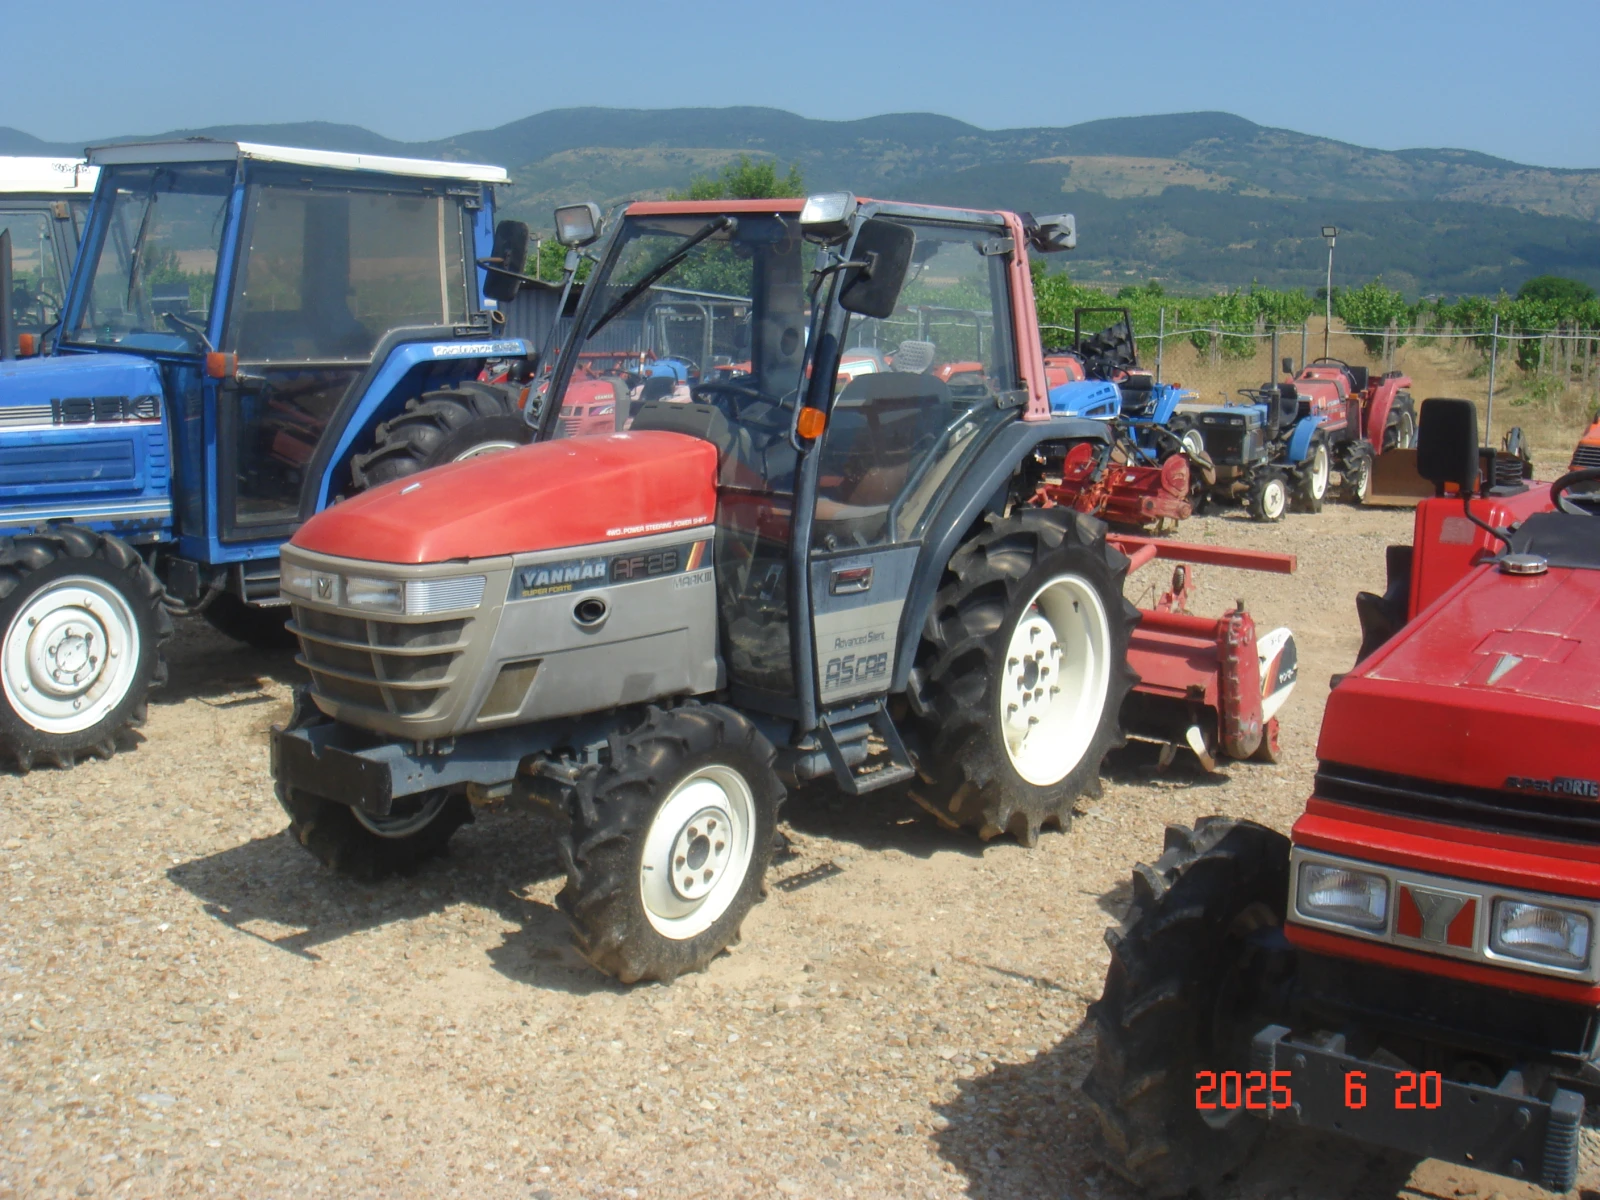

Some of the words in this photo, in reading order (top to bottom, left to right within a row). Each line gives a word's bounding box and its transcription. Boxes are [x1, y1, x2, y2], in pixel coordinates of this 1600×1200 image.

[51, 394, 161, 426] ISEKI
[520, 562, 606, 587] YANMAR
[673, 574, 704, 590] MARK
[522, 586, 548, 597] SUPER
[549, 584, 572, 593] FORTE
[834, 634, 867, 650] Advanced
